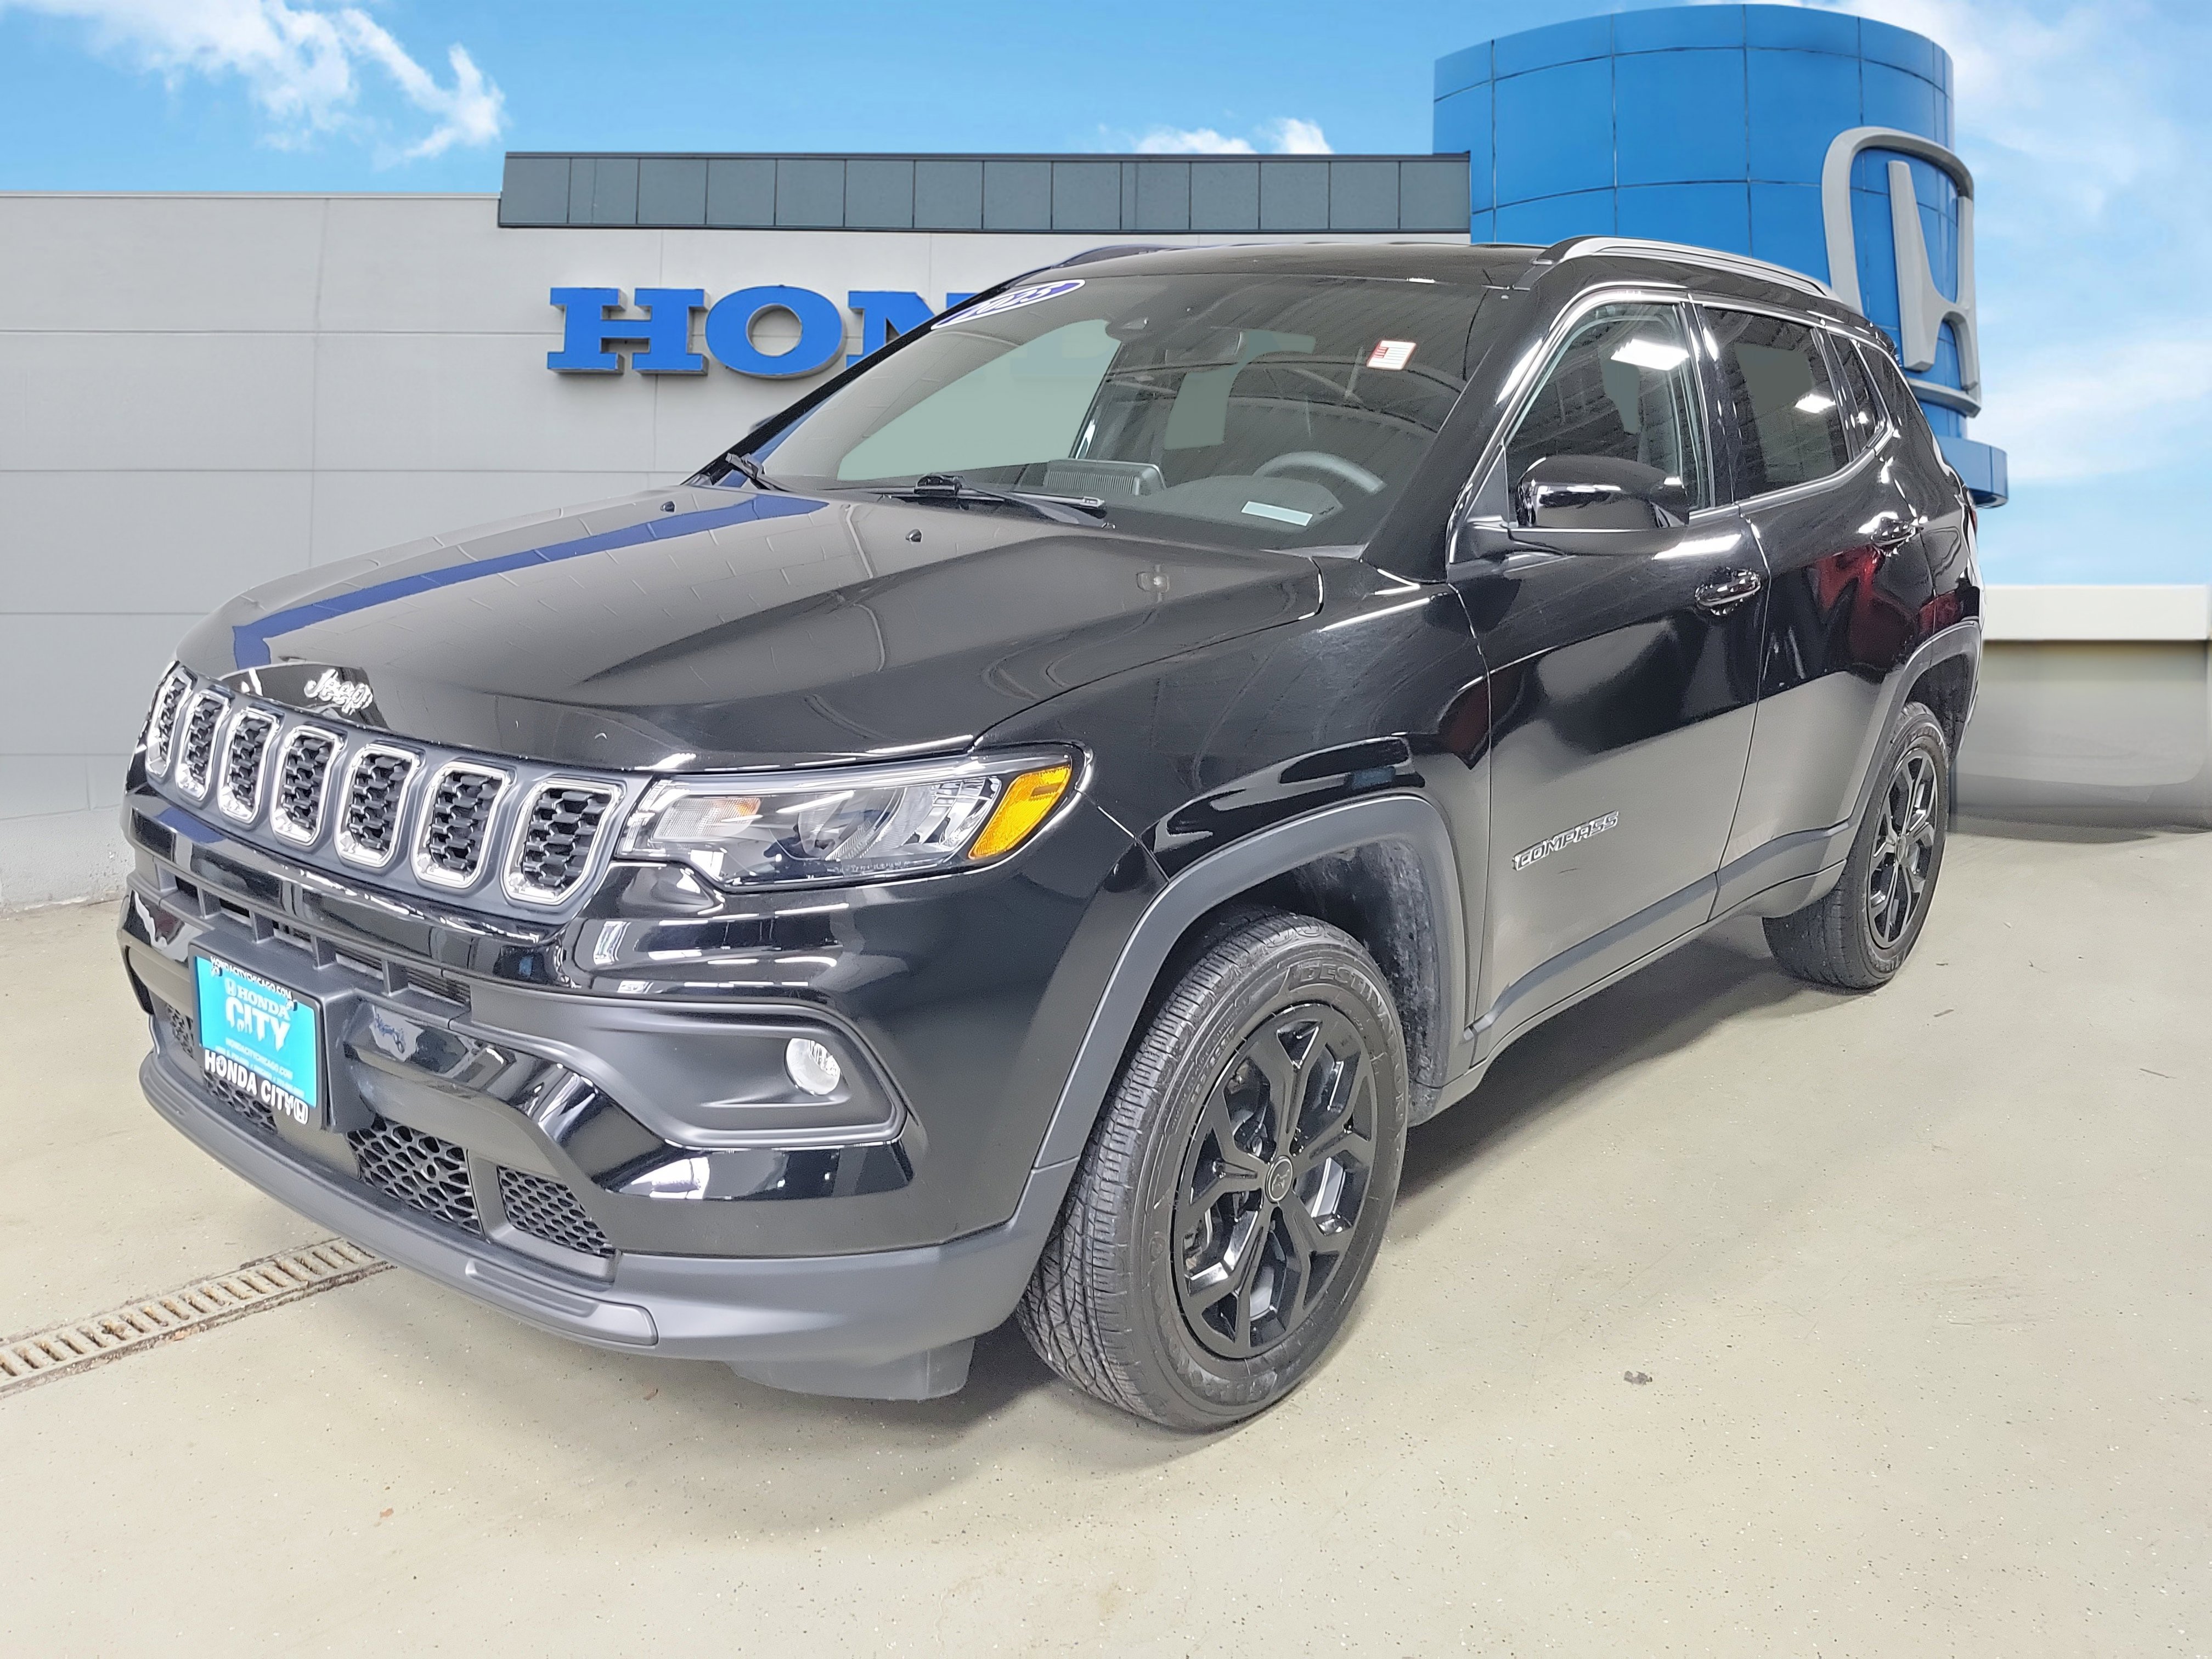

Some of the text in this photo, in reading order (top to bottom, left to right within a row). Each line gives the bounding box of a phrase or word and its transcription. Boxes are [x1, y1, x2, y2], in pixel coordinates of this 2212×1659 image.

[304, 669, 373, 715] Jeep
[1512, 810, 1619, 871] COMPASS
[225, 996, 290, 1052] CITY
[237, 985, 291, 1020] HONDA
[205, 1049, 257, 1096] HONDA
[261, 1080, 295, 1116] CITY
